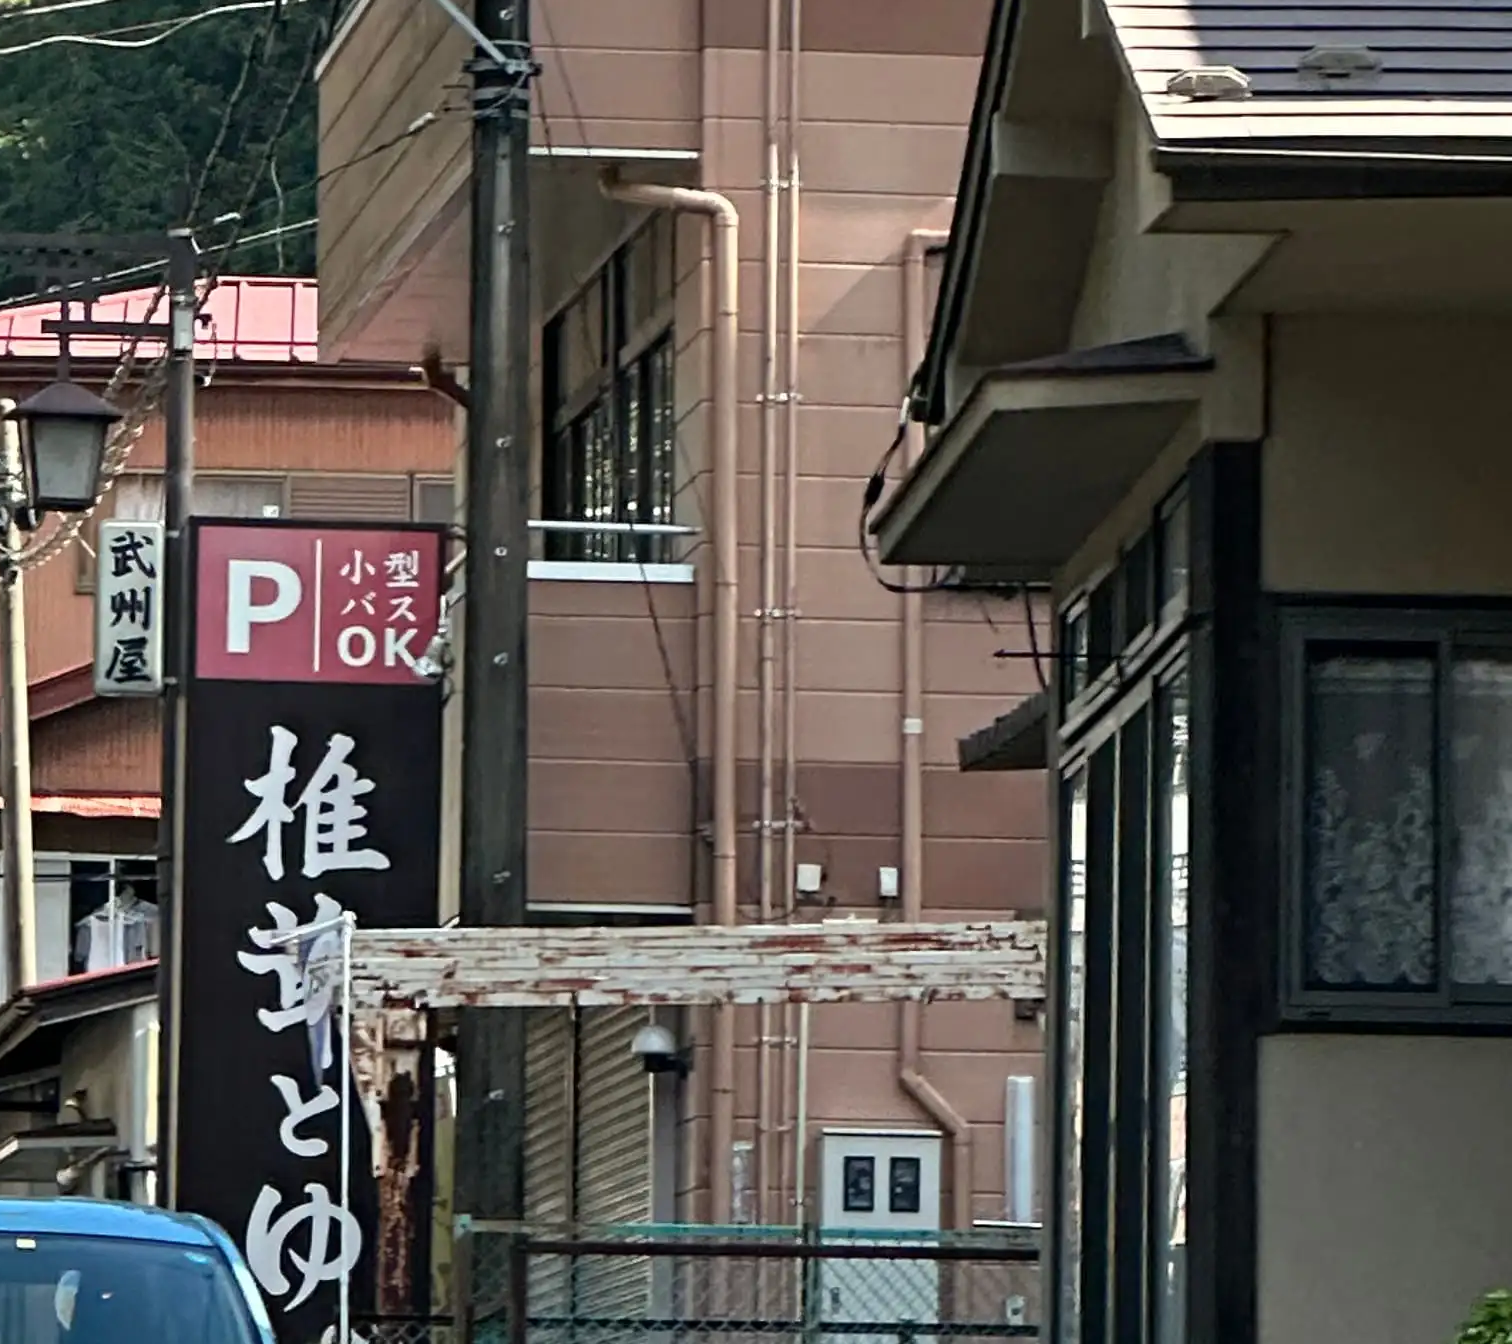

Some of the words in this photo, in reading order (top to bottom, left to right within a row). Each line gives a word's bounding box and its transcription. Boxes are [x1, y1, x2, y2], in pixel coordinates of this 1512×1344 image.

[340, 549, 421, 588] 小型
[104, 530, 157, 684] 武州屋
[226, 559, 303, 654] P
[340, 591, 418, 622] バス
[337, 625, 419, 668] OK
